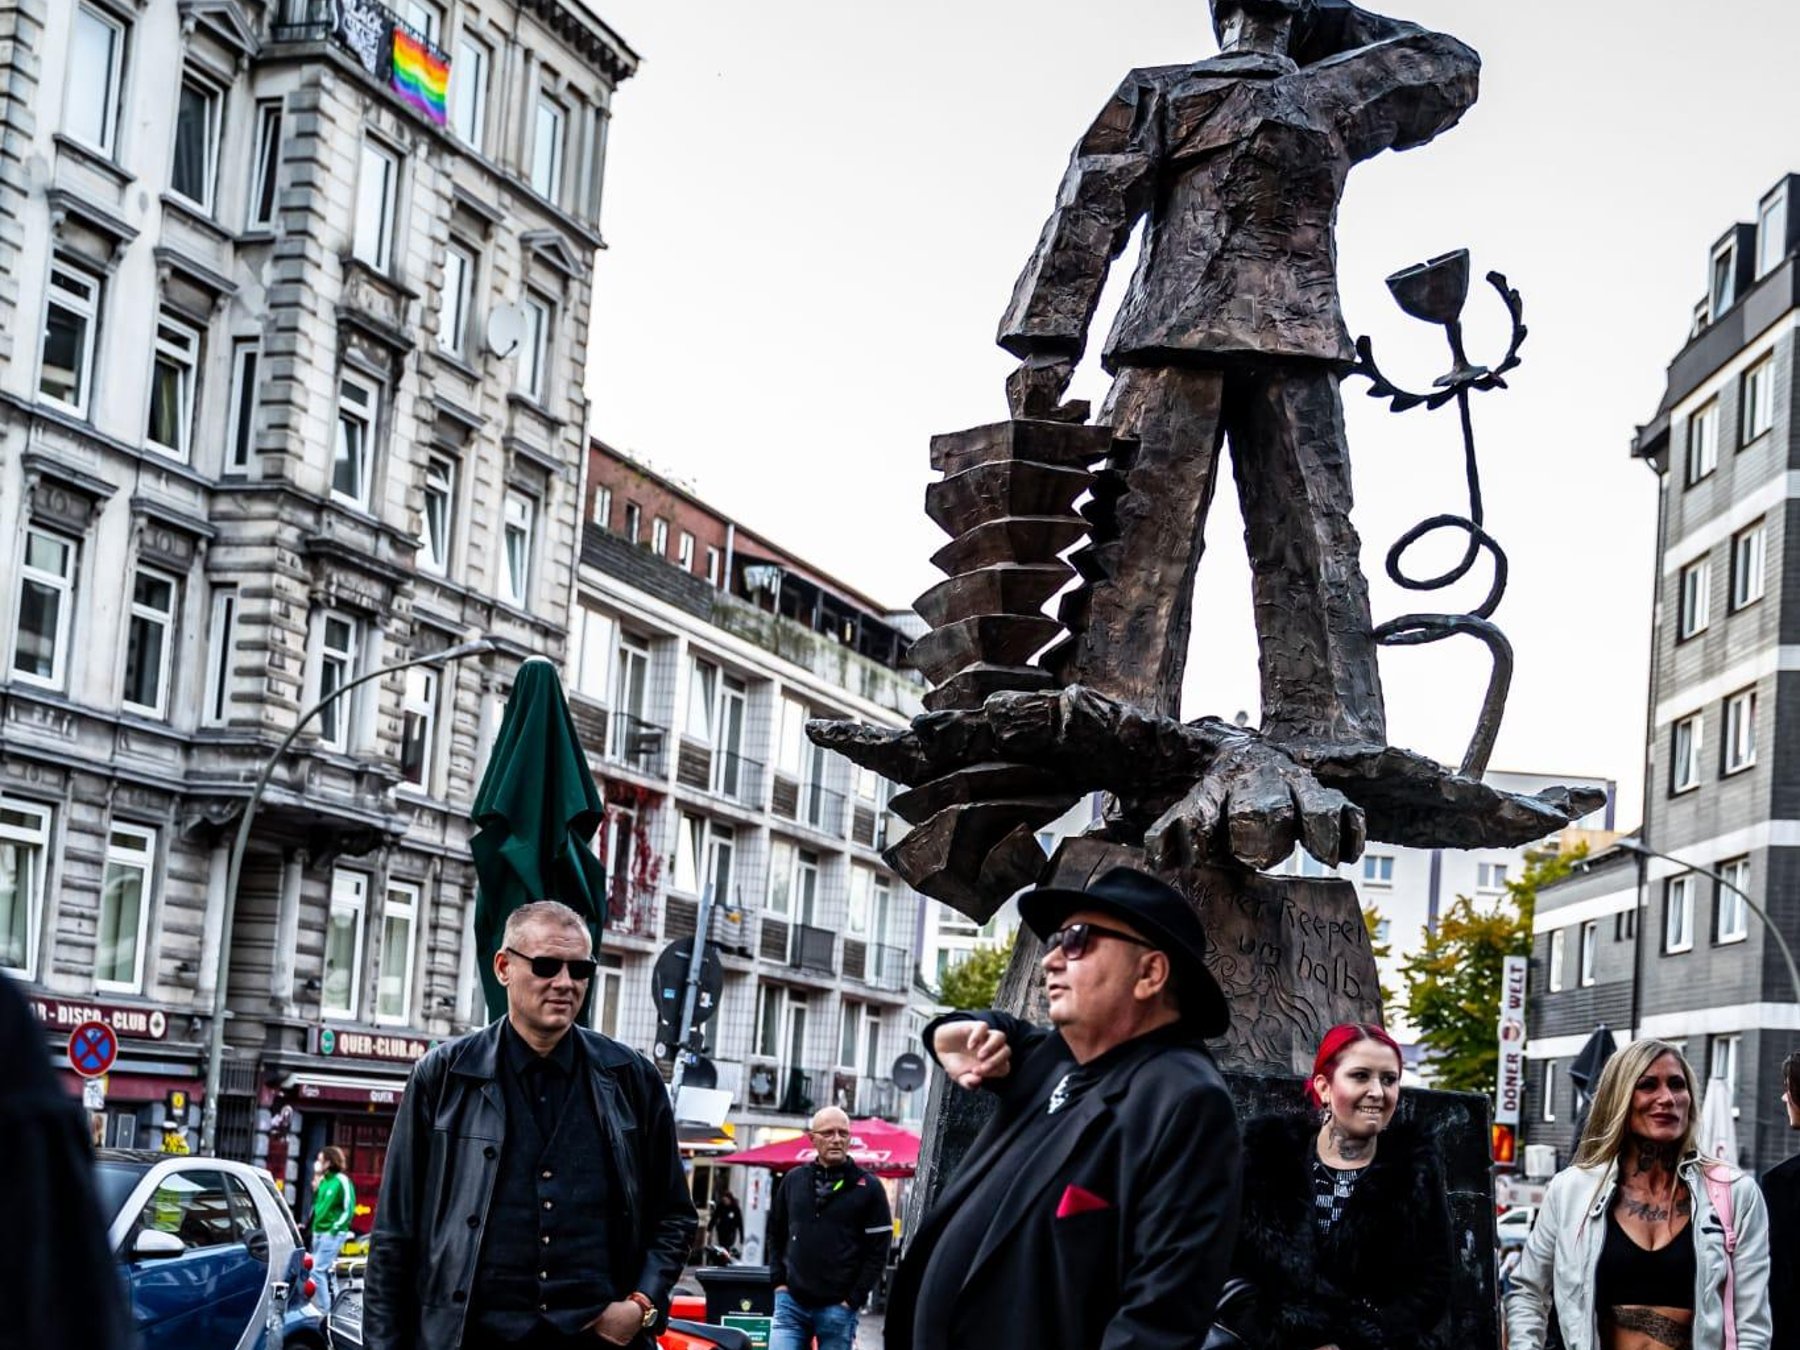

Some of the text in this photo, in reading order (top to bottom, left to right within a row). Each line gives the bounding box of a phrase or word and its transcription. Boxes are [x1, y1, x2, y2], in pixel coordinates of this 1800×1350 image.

[1298, 942, 1361, 999] halb
[1509, 965, 1524, 1009] WELT
[57, 1005, 102, 1024] DISCO
[112, 1011, 147, 1032] CLUB
[339, 1033, 426, 1059] QUER-CLUB.de
[370, 1090, 394, 1104] QUER
